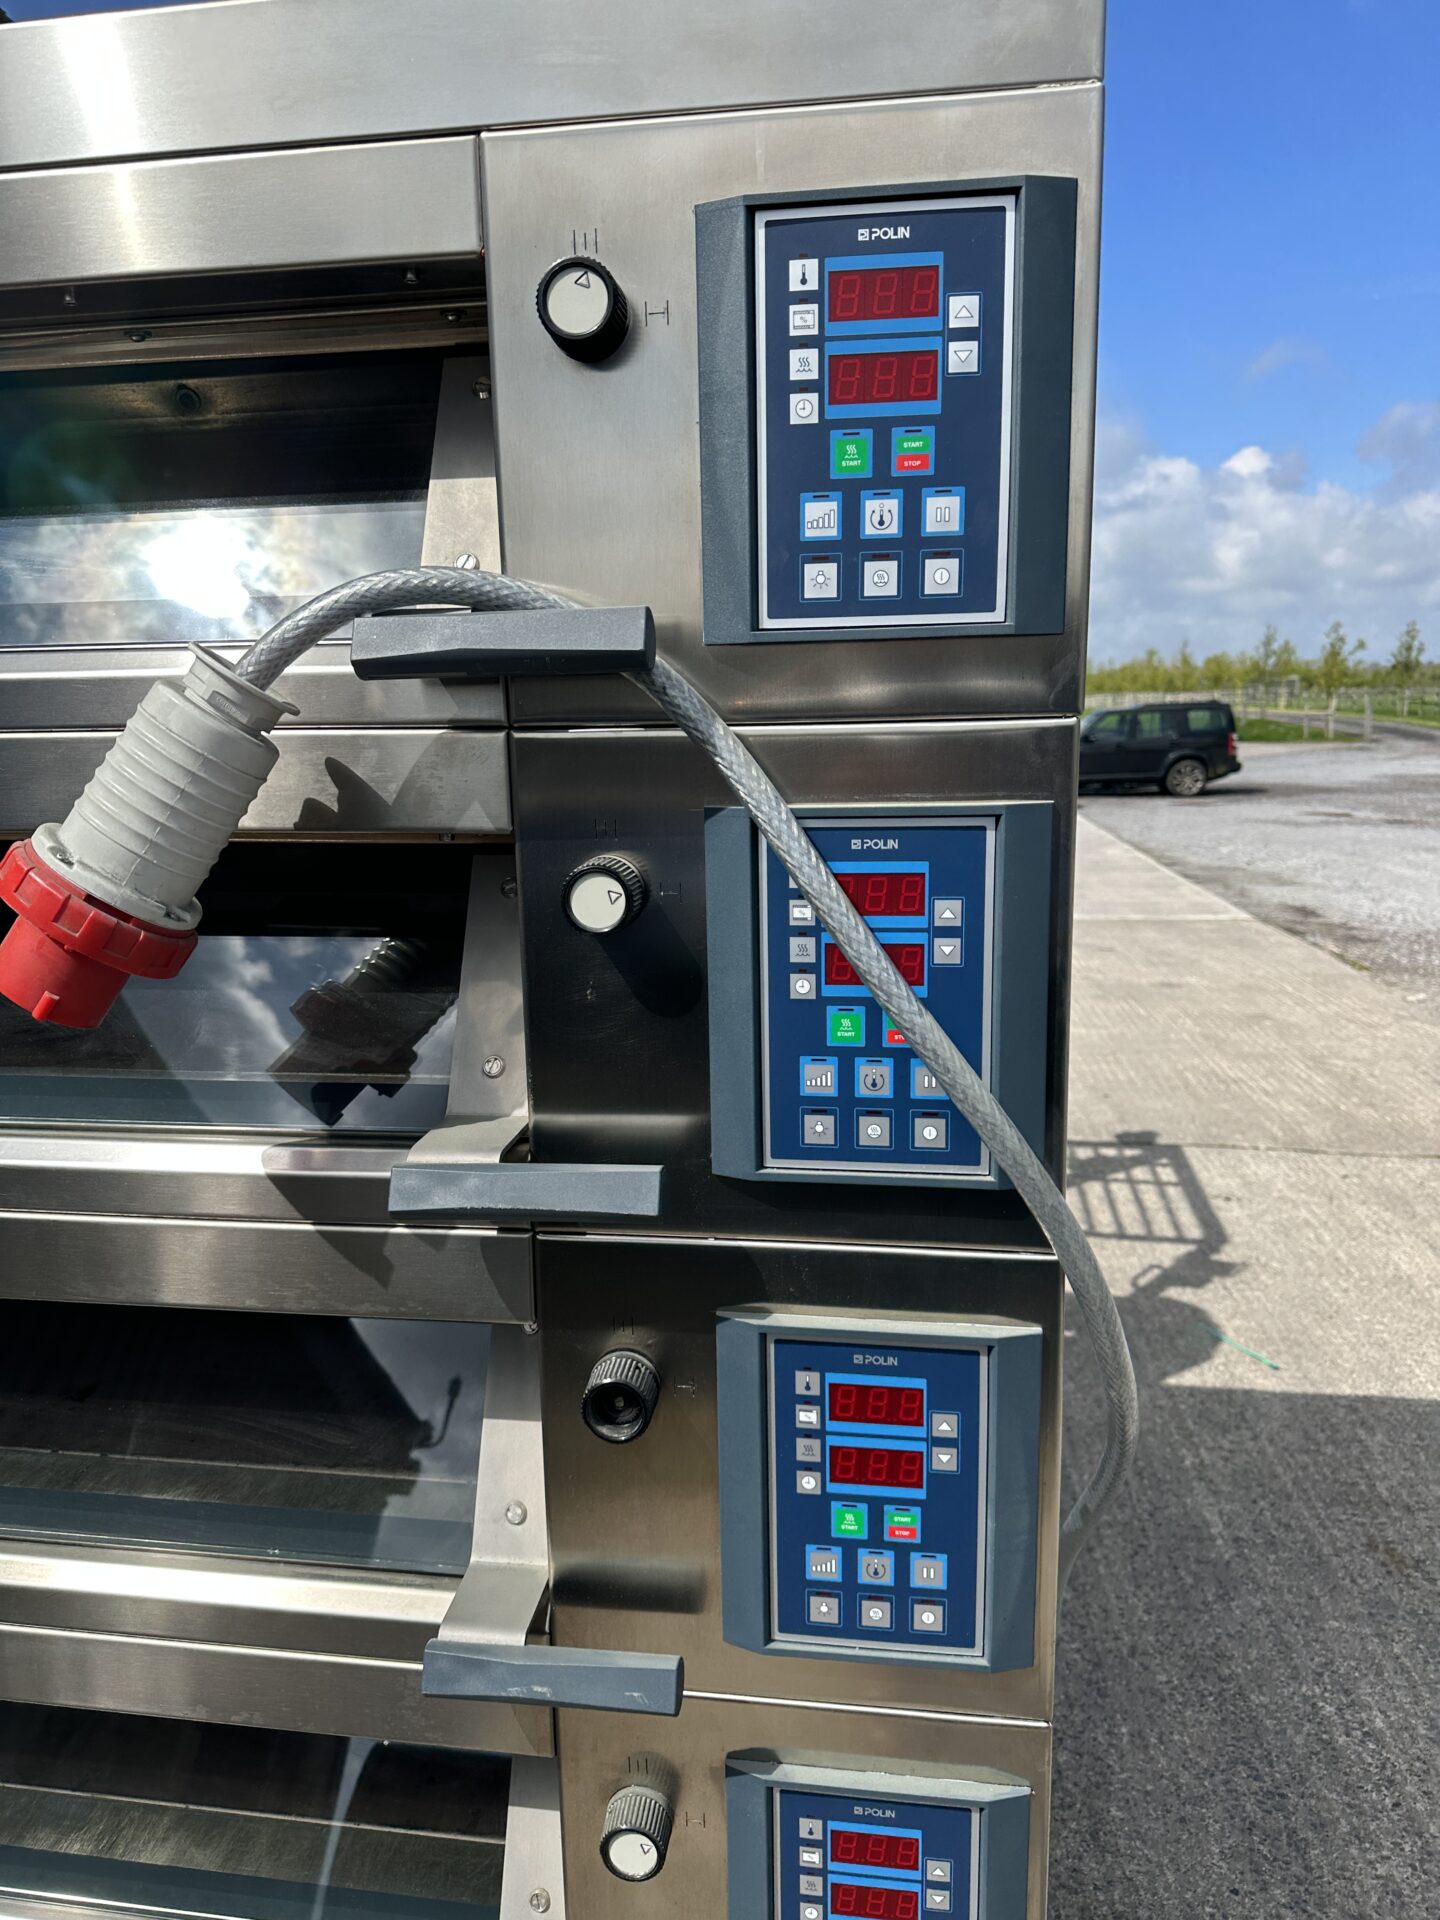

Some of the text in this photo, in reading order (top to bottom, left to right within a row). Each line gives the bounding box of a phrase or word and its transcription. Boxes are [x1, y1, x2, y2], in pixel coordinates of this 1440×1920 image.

[871, 226, 910, 240] POLIN
[864, 838, 898, 849] POLIN
[865, 1355, 898, 1366] POLIN
[864, 1807, 896, 1818] POLIN
